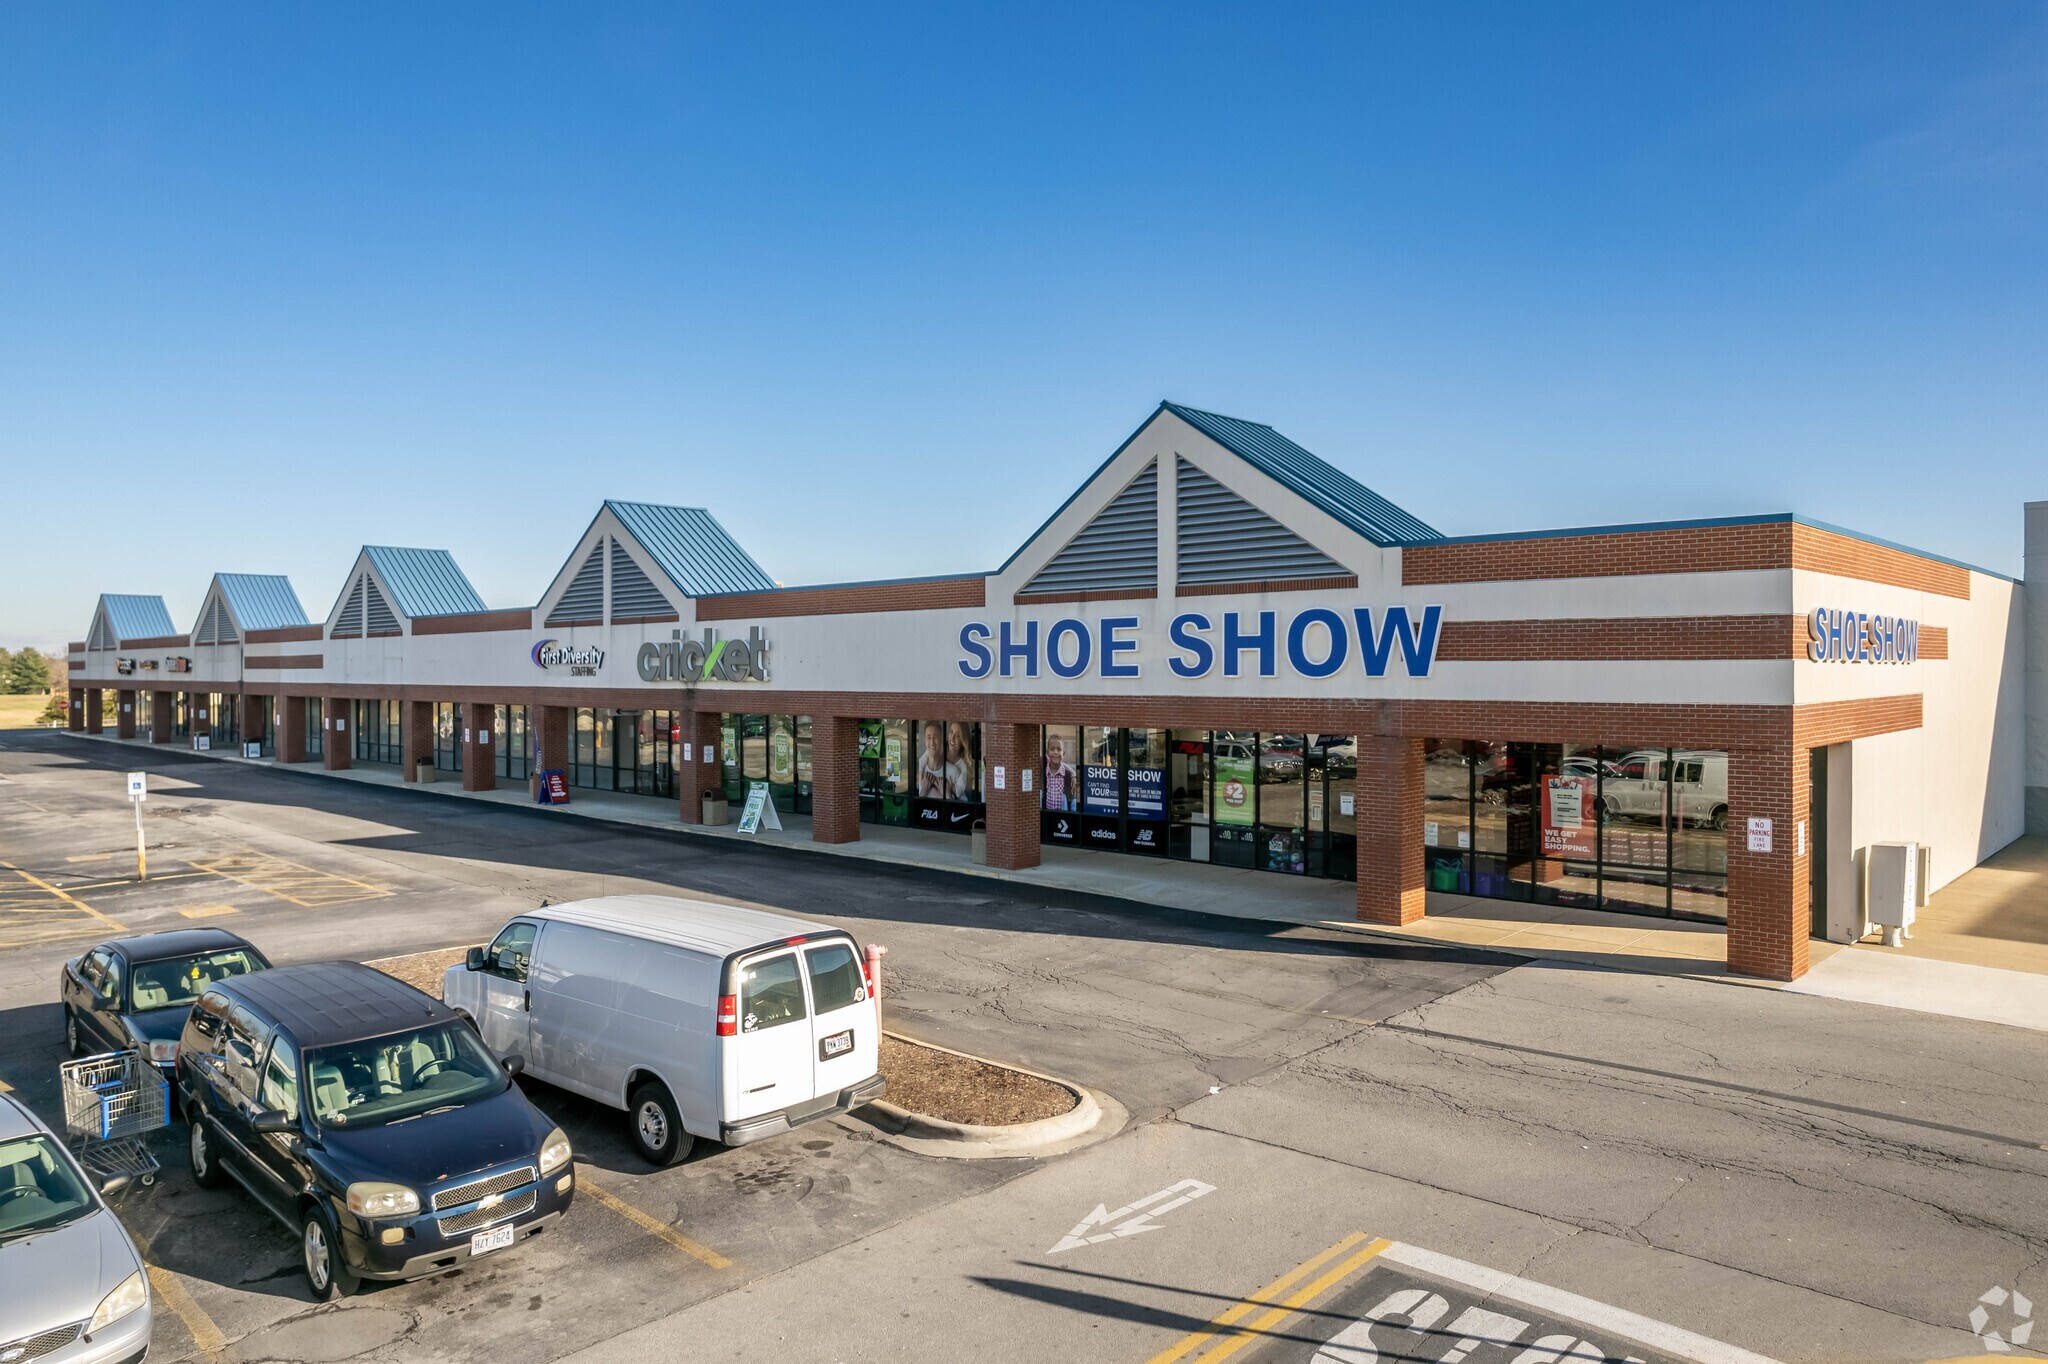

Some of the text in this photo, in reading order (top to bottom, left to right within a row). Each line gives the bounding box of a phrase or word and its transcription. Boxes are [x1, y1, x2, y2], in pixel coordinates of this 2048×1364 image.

[1812, 607, 1918, 662] SHOE SHOW
[957, 603, 1446, 680] SHOE SHOW
[541, 646, 605, 669] First Diversity
[637, 626, 767, 682] cricket
[571, 666, 596, 676] STAFFING
[1178, 742, 1204, 753] FILA
[1087, 767, 1161, 782] SHOE SHOW
[1091, 787, 1110, 796] YOUR
[1226, 783, 1243, 799] $2
[921, 809, 938, 819] FILA
[1091, 829, 1116, 840] adidas
[1545, 829, 1577, 838] WE GET
[1545, 836, 1567, 844] EASY
[1544, 843, 1590, 853] SHOPPING.
[837, 1036, 849, 1047] 3739
[492, 1230, 511, 1244] 7624
[1308, 1289, 1648, 1364] ST
